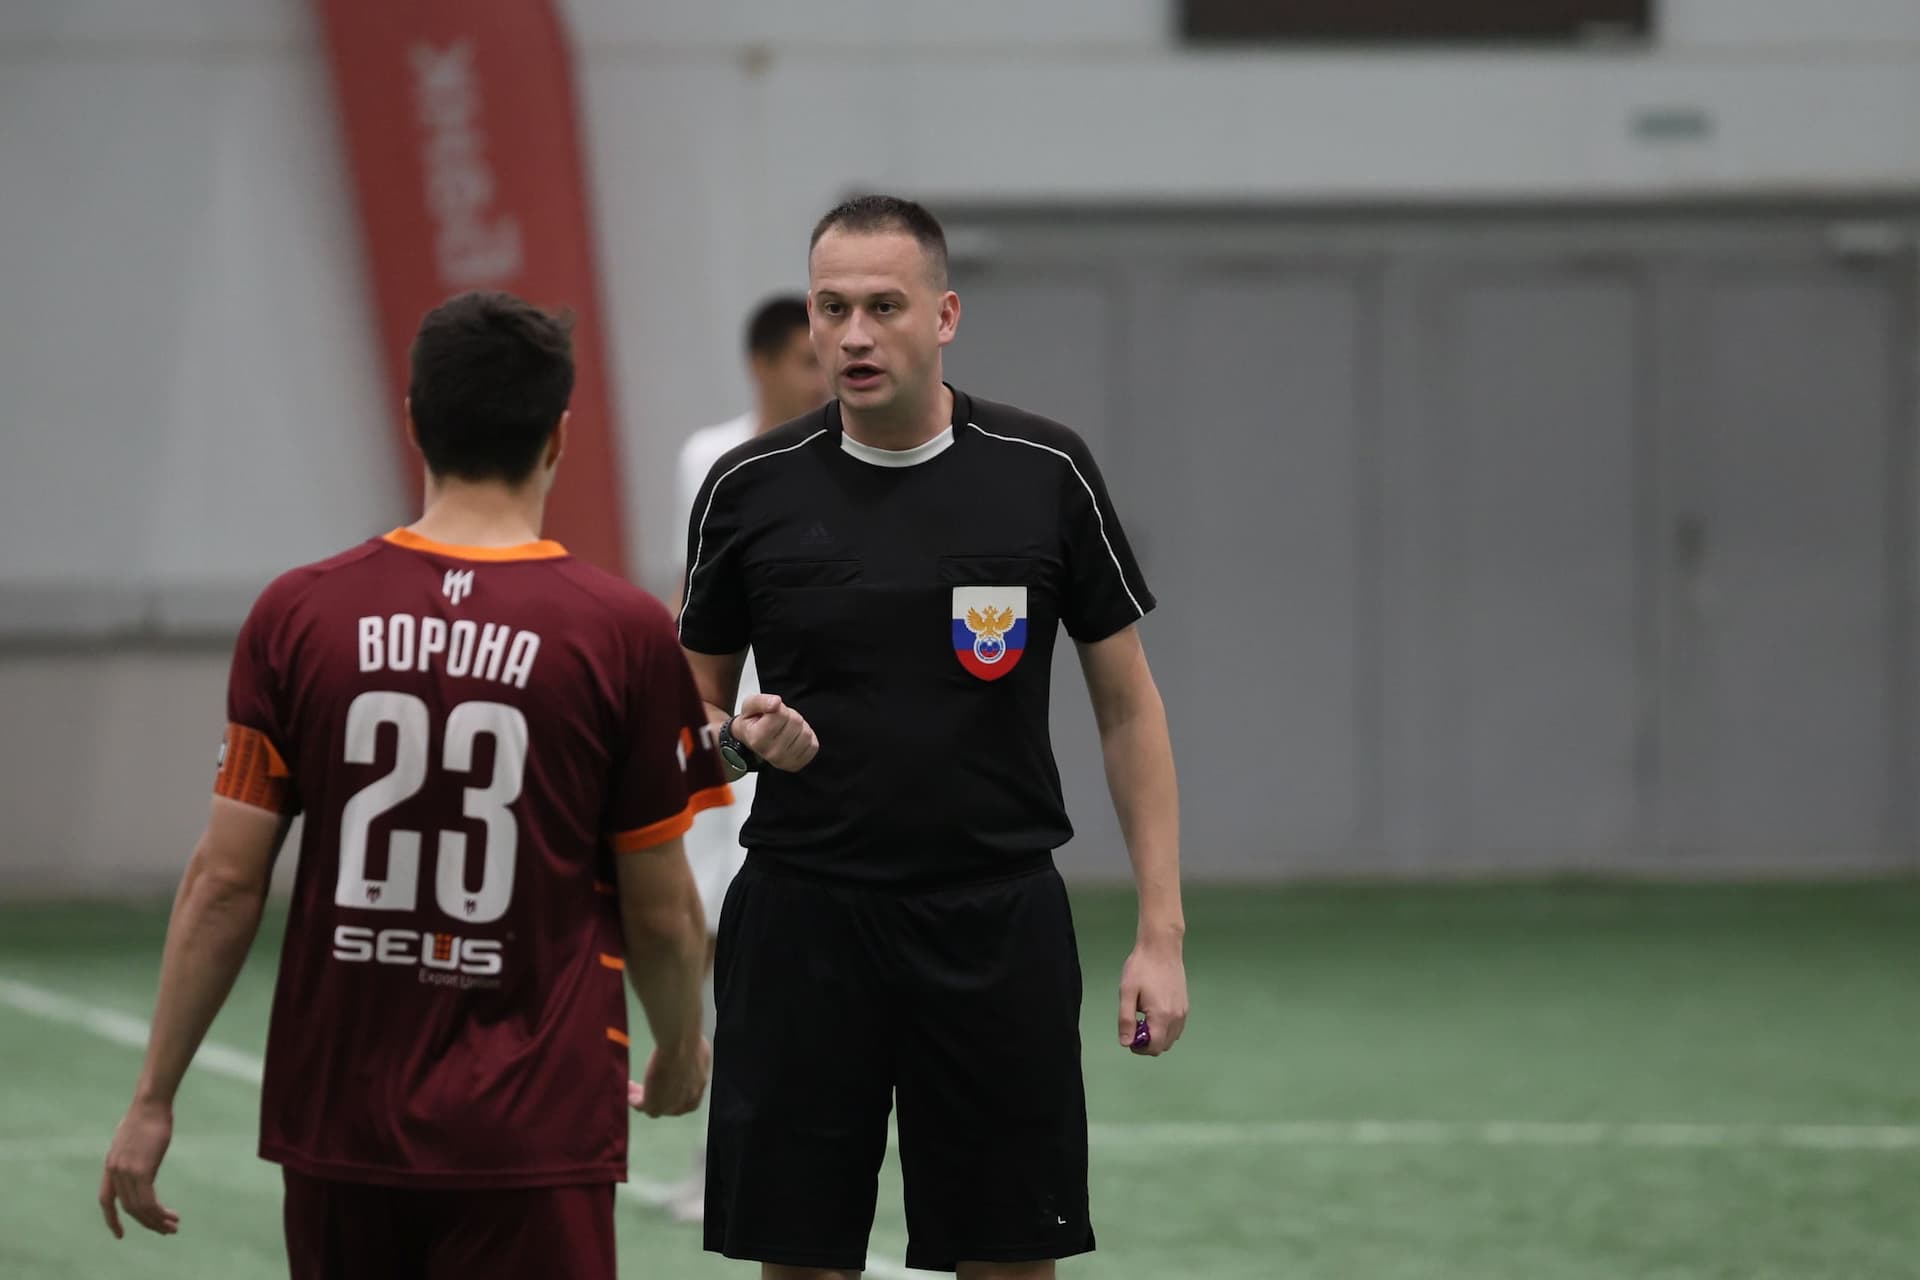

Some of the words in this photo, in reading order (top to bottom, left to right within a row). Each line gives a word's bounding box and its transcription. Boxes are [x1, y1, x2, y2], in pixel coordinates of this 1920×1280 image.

[358, 613, 541, 689] ВОРОНА
[334, 691, 529, 923] 23
[333, 925, 503, 975] SEUS
